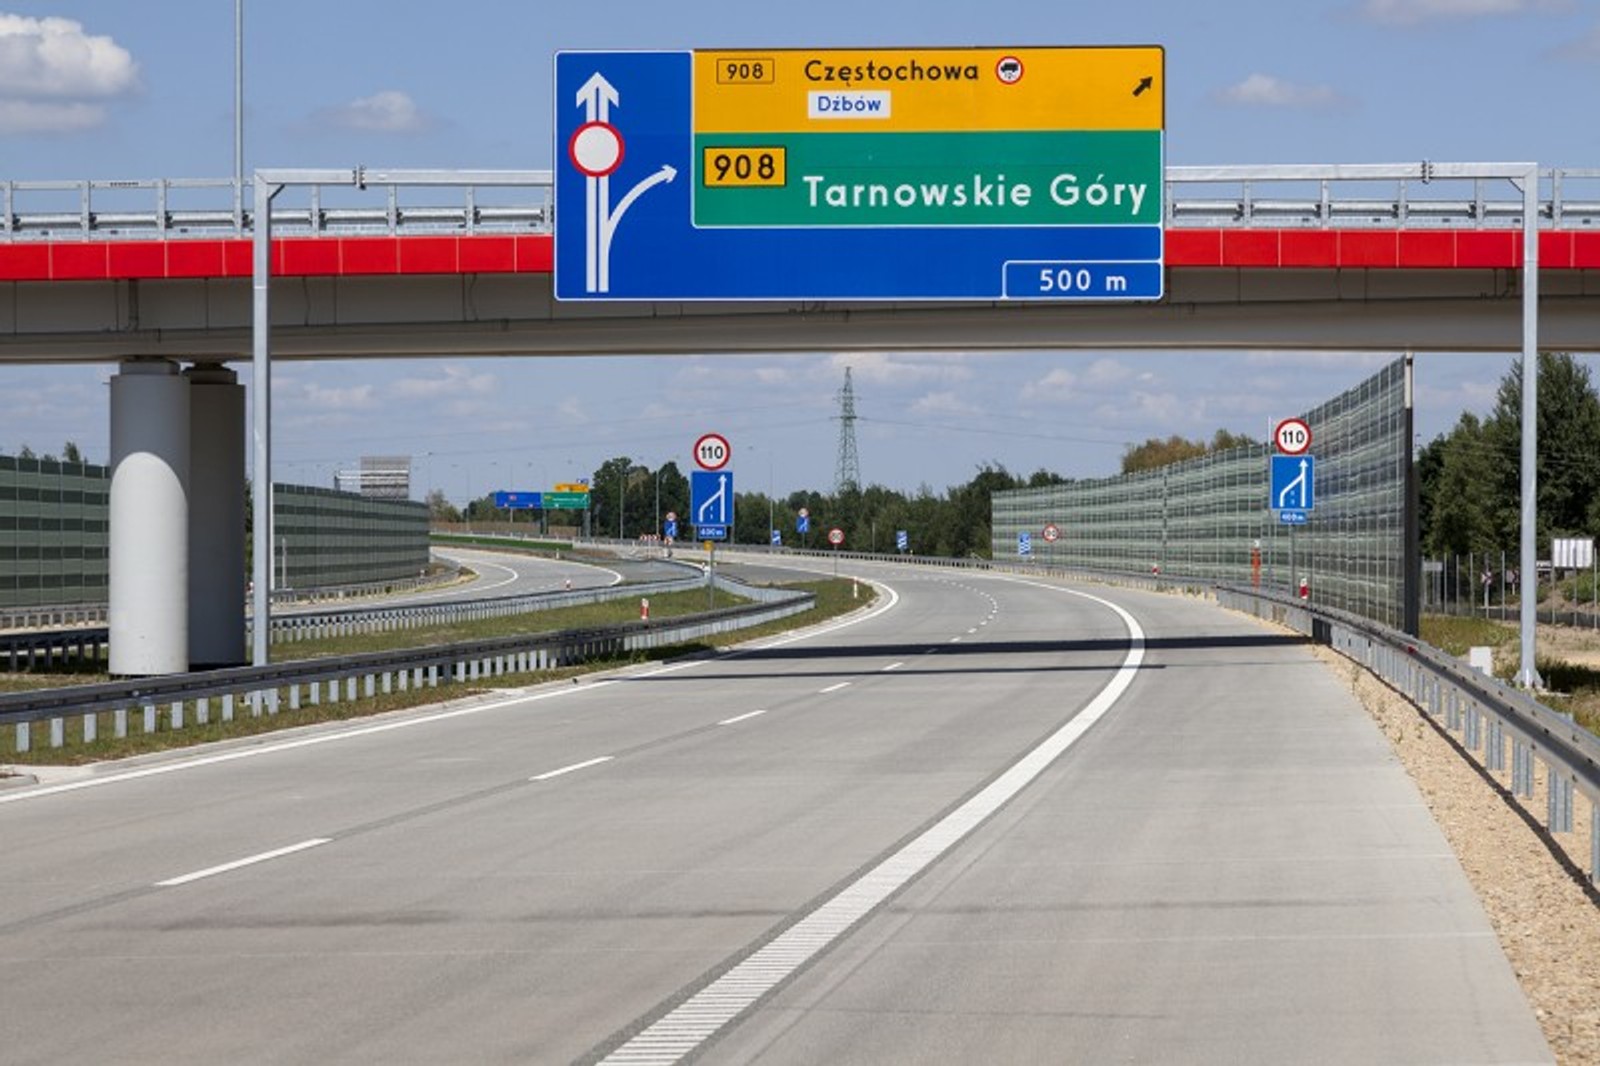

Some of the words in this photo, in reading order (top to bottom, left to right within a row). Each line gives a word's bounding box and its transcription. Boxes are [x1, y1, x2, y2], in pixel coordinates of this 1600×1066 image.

[726, 63, 764, 80] 908
[804, 60, 979, 86] Częstochowa
[817, 94, 882, 112] Dźbów
[714, 153, 775, 180] 908
[803, 175, 1032, 207] Tarnowskie
[1049, 174, 1147, 216] Góry
[1039, 269, 1091, 291] 500
[1105, 275, 1127, 291] m
[1281, 429, 1305, 444] 110
[701, 445, 724, 460] 110
